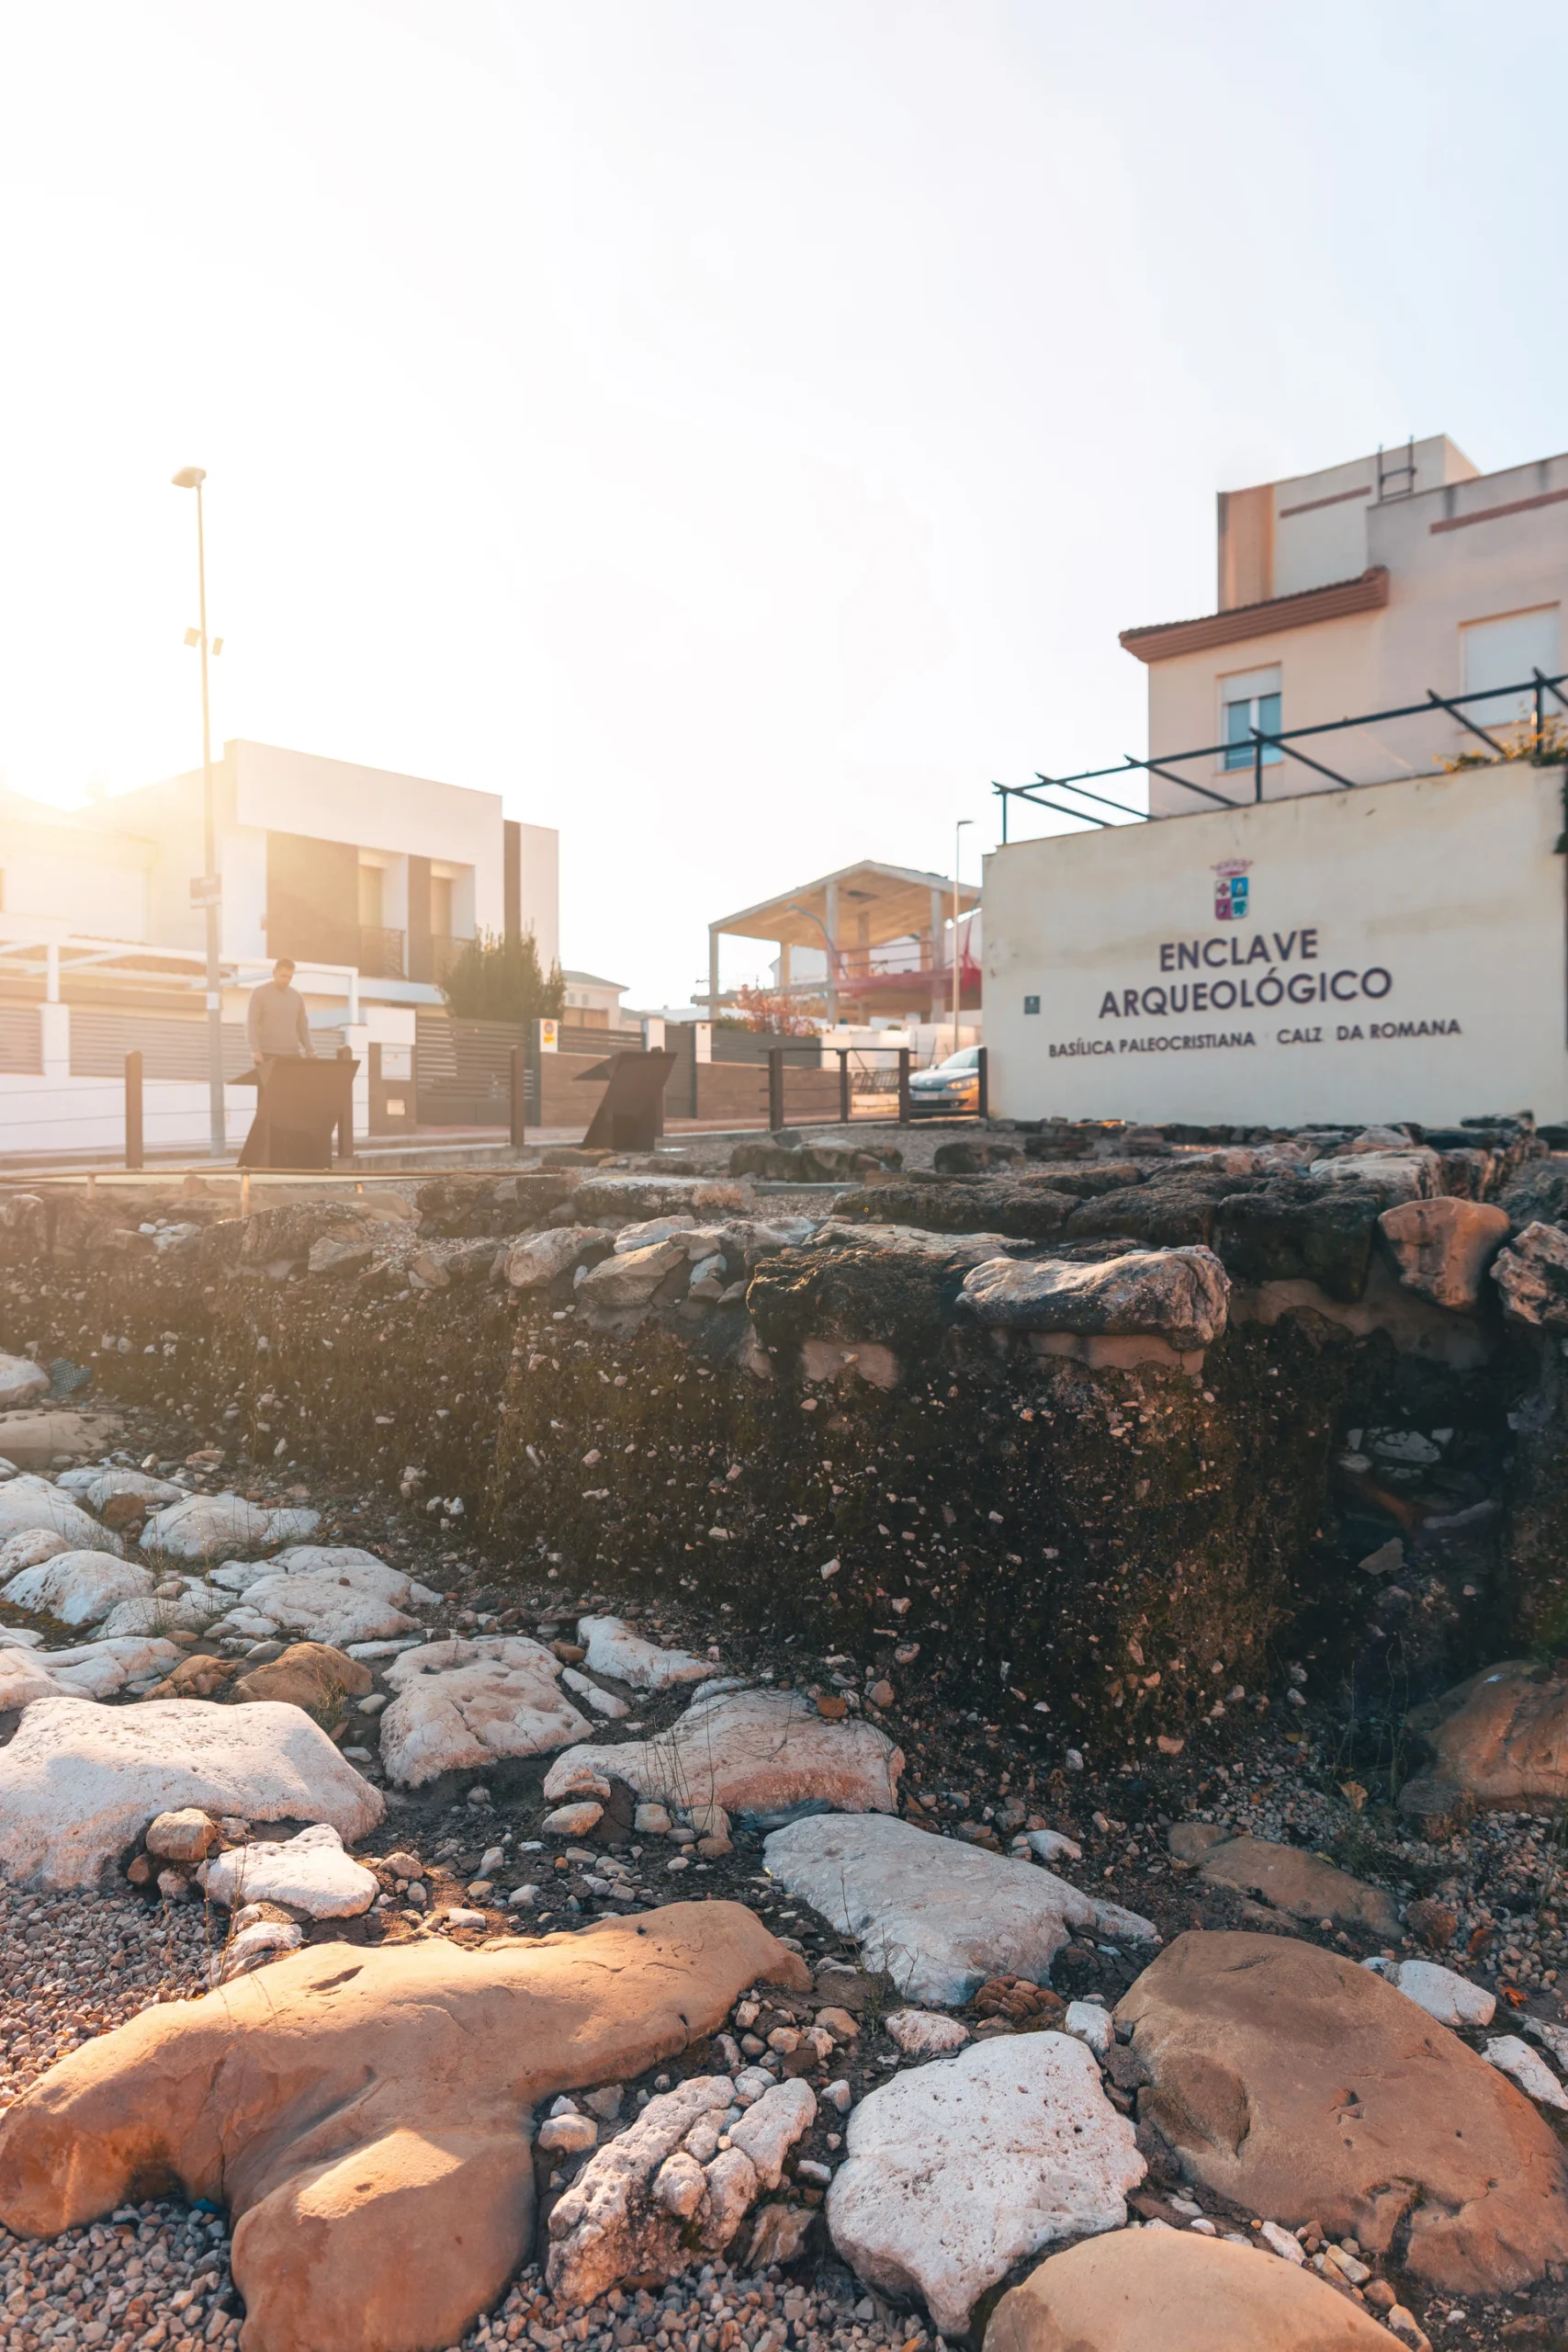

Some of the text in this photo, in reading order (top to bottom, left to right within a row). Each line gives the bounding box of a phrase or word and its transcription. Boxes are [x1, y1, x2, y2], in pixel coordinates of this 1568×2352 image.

[1159, 928, 1318, 972] ENCLAVE
[1099, 967, 1393, 1019] ARQUEOLÓGICO
[1049, 1038, 1115, 1057] BASÍLICA
[1119, 1031, 1257, 1054] PALEOCRISTIANA
[1370, 1019, 1462, 1039] ROMANA
